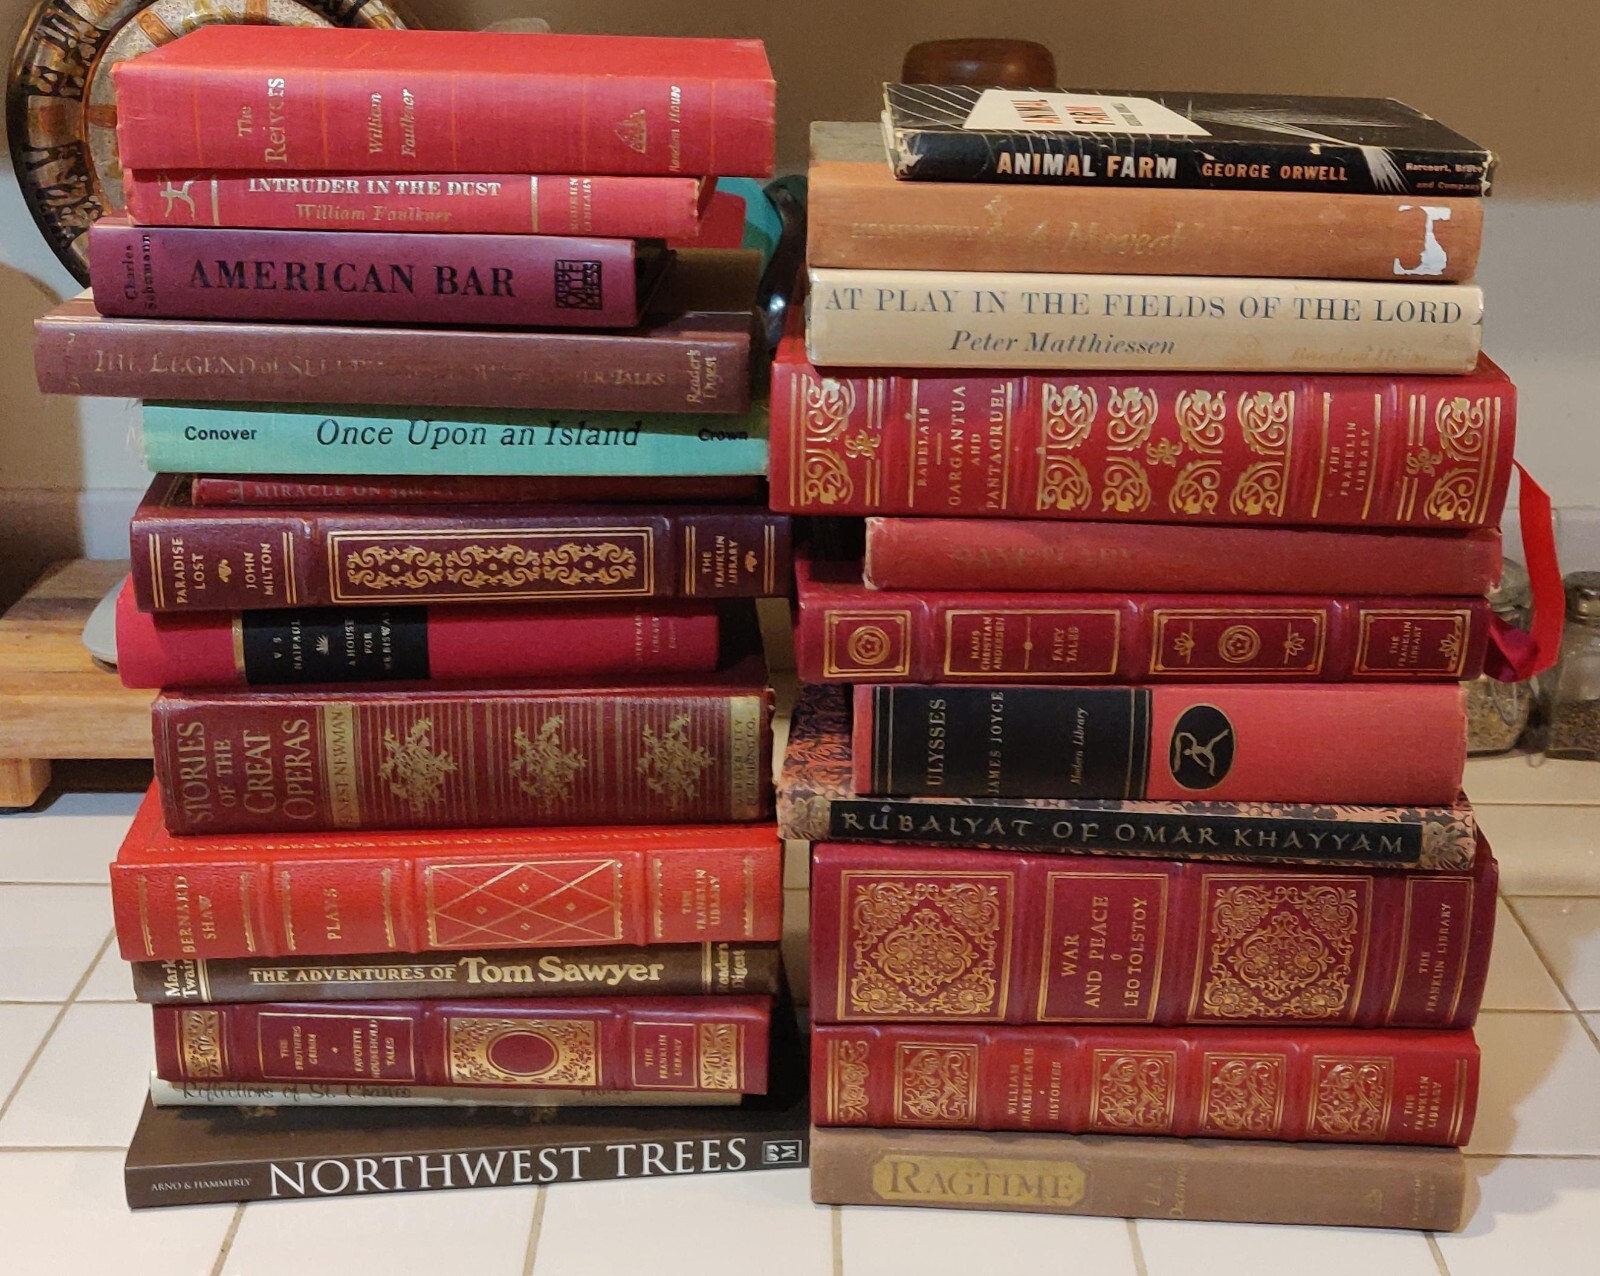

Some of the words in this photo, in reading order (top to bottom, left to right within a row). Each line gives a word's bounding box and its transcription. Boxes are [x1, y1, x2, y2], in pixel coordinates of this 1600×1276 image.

[237, 105, 253, 137] The
[265, 77, 288, 163] Reivers
[367, 92, 383, 155] William
[401, 88, 418, 158] Faulkner
[247, 176, 360, 195] INTRUDER
[366, 178, 392, 196] IN
[395, 179, 441, 197] THE
[446, 180, 502, 197] DUST
[996, 152, 1096, 178] ANIMAL
[1106, 155, 1178, 180] FARM
[1201, 162, 1272, 179] GEORGE
[1279, 165, 1348, 182] ORWELL
[295, 202, 366, 222] William
[372, 204, 453, 224] Faulkner
[189, 259, 417, 295] AMERICAN
[434, 264, 517, 299] BAR
[825, 287, 863, 312] AT
[875, 288, 960, 313] PLAY
[973, 290, 1008, 314] IN
[1020, 292, 1090, 316] THE
[1103, 293, 1227, 319] FIELDS
[1239, 296, 1282, 320] OF
[1293, 297, 1361, 323] THE
[1372, 299, 1463, 325] LORD
[949, 328, 1019, 352] Peter
[1023, 331, 1177, 355] Matthiessen
[184, 425, 258, 441] Conover
[316, 417, 394, 446] Once
[406, 418, 487, 450] Upon
[499, 424, 536, 447] an
[543, 419, 643, 448] Island
[697, 427, 749, 443] Crown
[917, 406, 931, 488] RABELAIS
[949, 385, 967, 507] GARGANTUA
[971, 432, 983, 467] AND
[985, 383, 1006, 510] PANTAGRUEL
[1340, 421, 1358, 497] FRANKLIN
[1356, 427, 1372, 492] LIBRARY
[252, 483, 346, 498] MIRACLE
[171, 536, 189, 605] PARADISE
[193, 553, 206, 591] LOST
[245, 551, 256, 590] JOHN
[262, 542, 275, 597] MILTON
[702, 549, 713, 575] THE
[715, 535, 727, 589] FRANKLIN
[728, 539, 740, 585] LIBRARY
[971, 630, 981, 660] HANS
[981, 616, 994, 672] CHRISTIAN
[994, 616, 1006, 670] ANDERSEN
[1053, 627, 1065, 662] FAIRY
[1066, 626, 1080, 664] TALES
[992, 690, 1005, 744] JOYCE
[1072, 706, 1091, 747] Library
[214, 739, 233, 777] THE
[331, 710, 347, 776] NEWMAN
[926, 698, 947, 788] ULYSSES
[176, 721, 215, 824] STORIES
[243, 729, 277, 815] GREAT
[282, 718, 317, 820] OPERAS
[987, 750, 1003, 796] JAMES
[1069, 750, 1085, 786] Modern
[218, 785, 237, 808] OF
[1052, 820, 1101, 843] OF
[1114, 823, 1223, 847] OMAR
[1234, 828, 1404, 854] KHAYYAM
[174, 875, 196, 953] BERNARD
[198, 895, 217, 941] SHAW
[323, 887, 342, 941] PLAYS
[1088, 896, 1109, 961] PEACE
[1127, 897, 1148, 974] TOLSTOY
[1438, 903, 1452, 954] LIBRARY
[248, 968, 290, 983] THE
[295, 967, 425, 983] ADVENTURES
[429, 965, 456, 982] OF
[459, 956, 537, 984] Tom
[538, 955, 665, 986] Sawyer
[1061, 933, 1080, 977] WAR
[161, 959, 180, 997] Mark
[1084, 970, 1103, 1009] AND
[1124, 978, 1141, 1007] LEO
[280, 1038, 290, 1059] THE
[294, 1025, 305, 1071] BROTHERS
[309, 1033, 319, 1065] GRIMM
[353, 1027, 363, 1073] FAVORITE
[368, 1018, 381, 1079] HOUSEHOLD
[386, 1036, 396, 1066] TALES
[1008, 1064, 1020, 1115] WILLIAM
[151, 1181, 182, 1193] ARNO
[184, 1181, 192, 1191] &
[193, 1176, 251, 1190] HAMMERLY
[269, 1147, 591, 1197] NORTHWEST
[606, 1137, 748, 1178] TREES
[888, 1158, 1075, 1200] RAGTIME
